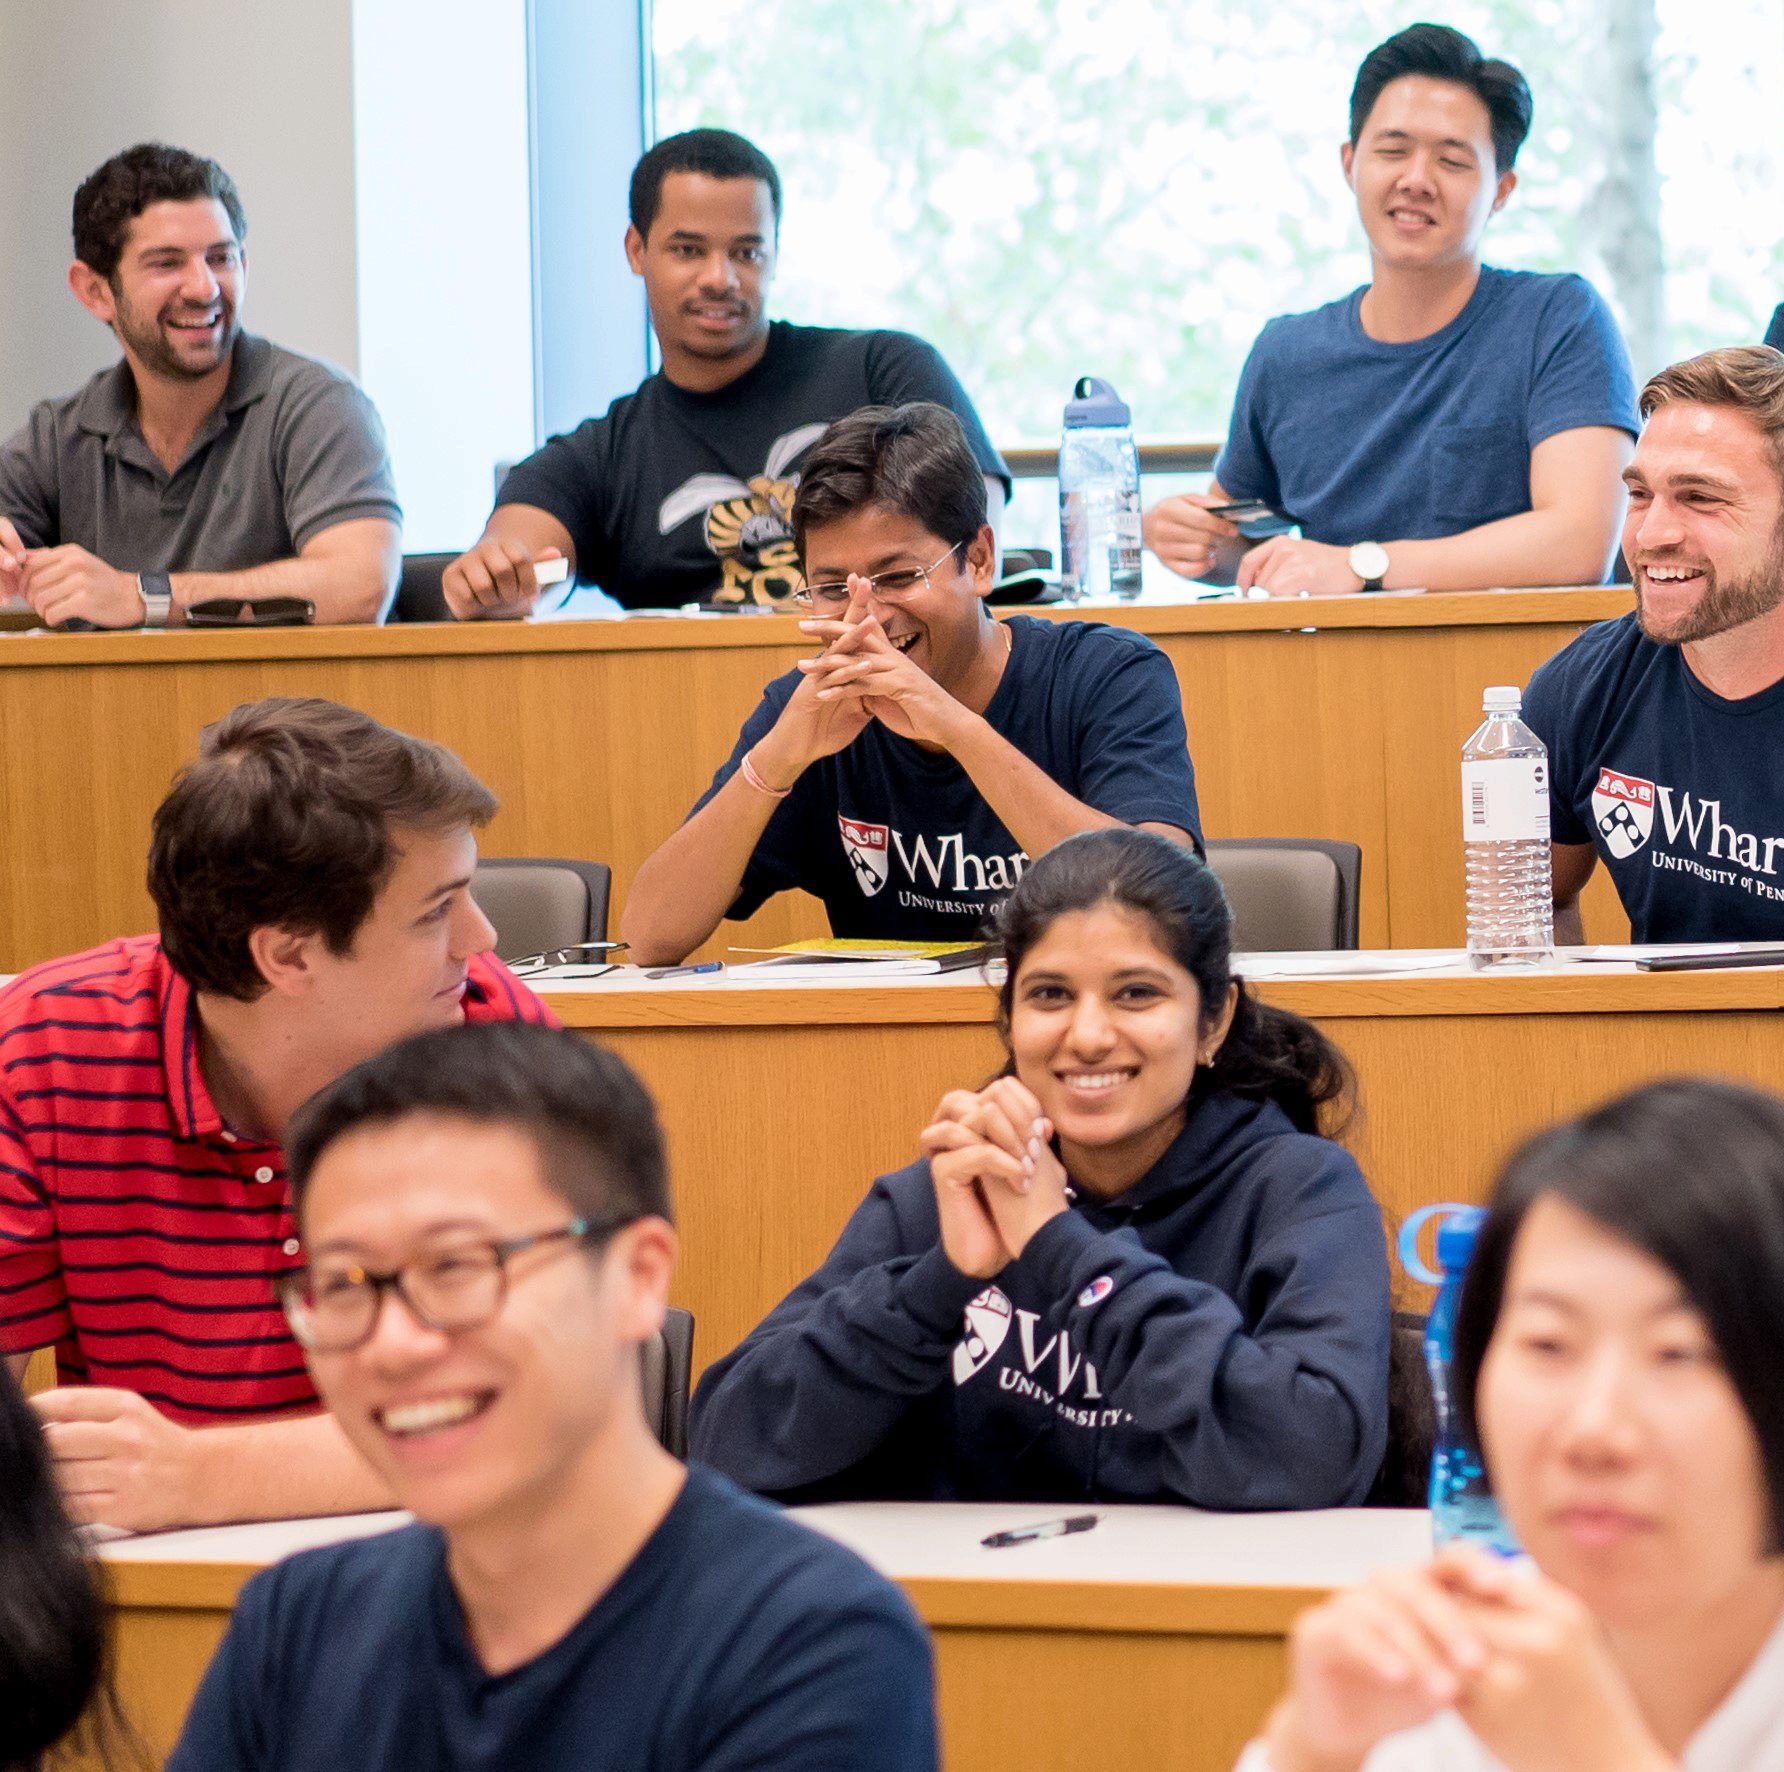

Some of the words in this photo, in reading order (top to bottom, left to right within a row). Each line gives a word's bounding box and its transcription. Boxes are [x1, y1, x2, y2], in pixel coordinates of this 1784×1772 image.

[891, 829, 1030, 891] Whar
[1652, 850, 1737, 886] UNIVERSITY
[1741, 876, 1754, 894] of
[898, 890, 985, 915] UNIVERSITY
